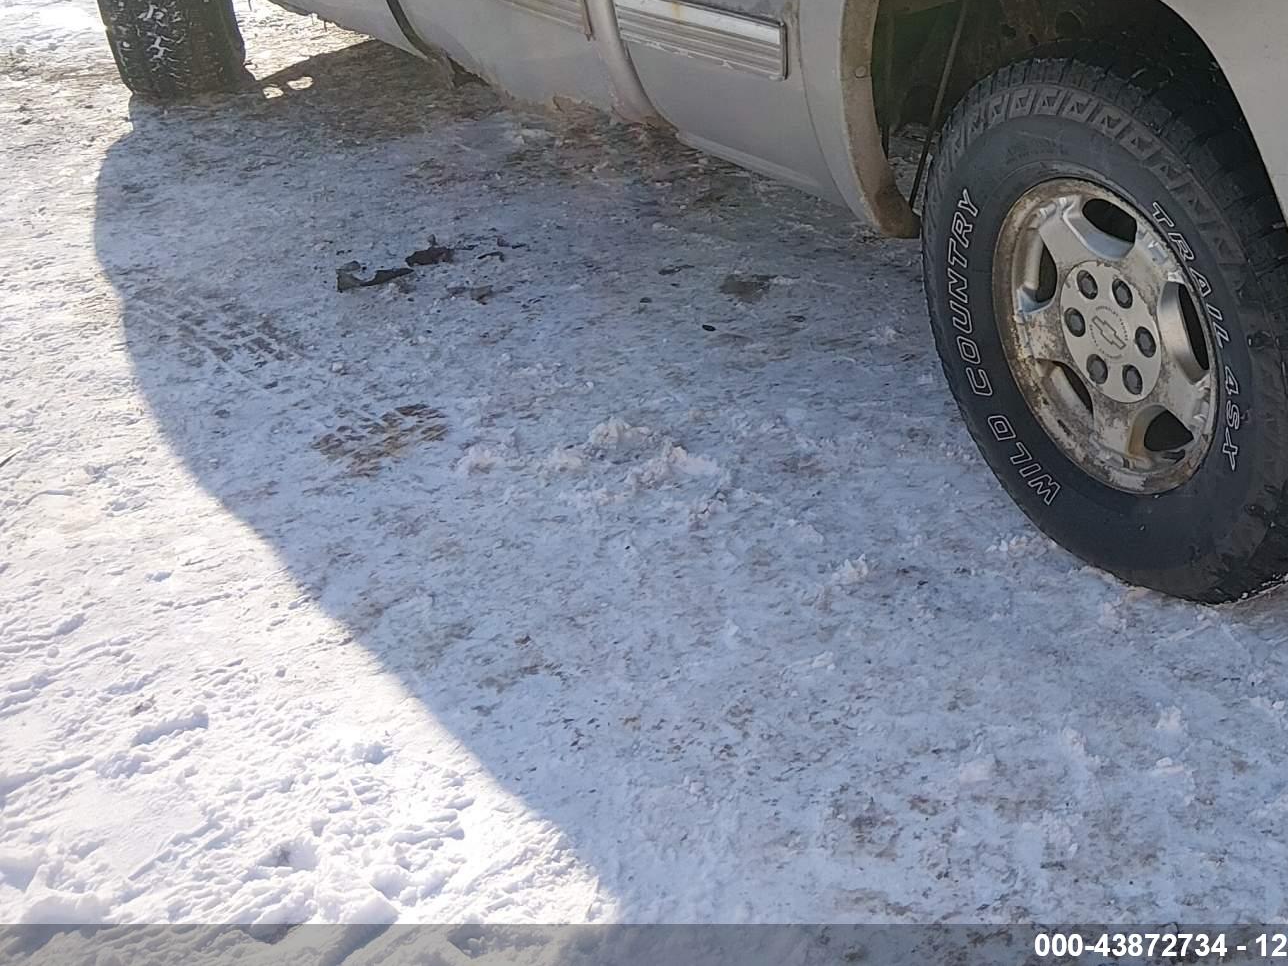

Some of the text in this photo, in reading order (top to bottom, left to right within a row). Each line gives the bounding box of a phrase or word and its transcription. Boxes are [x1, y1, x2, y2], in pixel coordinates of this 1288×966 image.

[947, 188, 1061, 506] WILD COUNTRY
[1152, 201, 1230, 349] TRAIL
